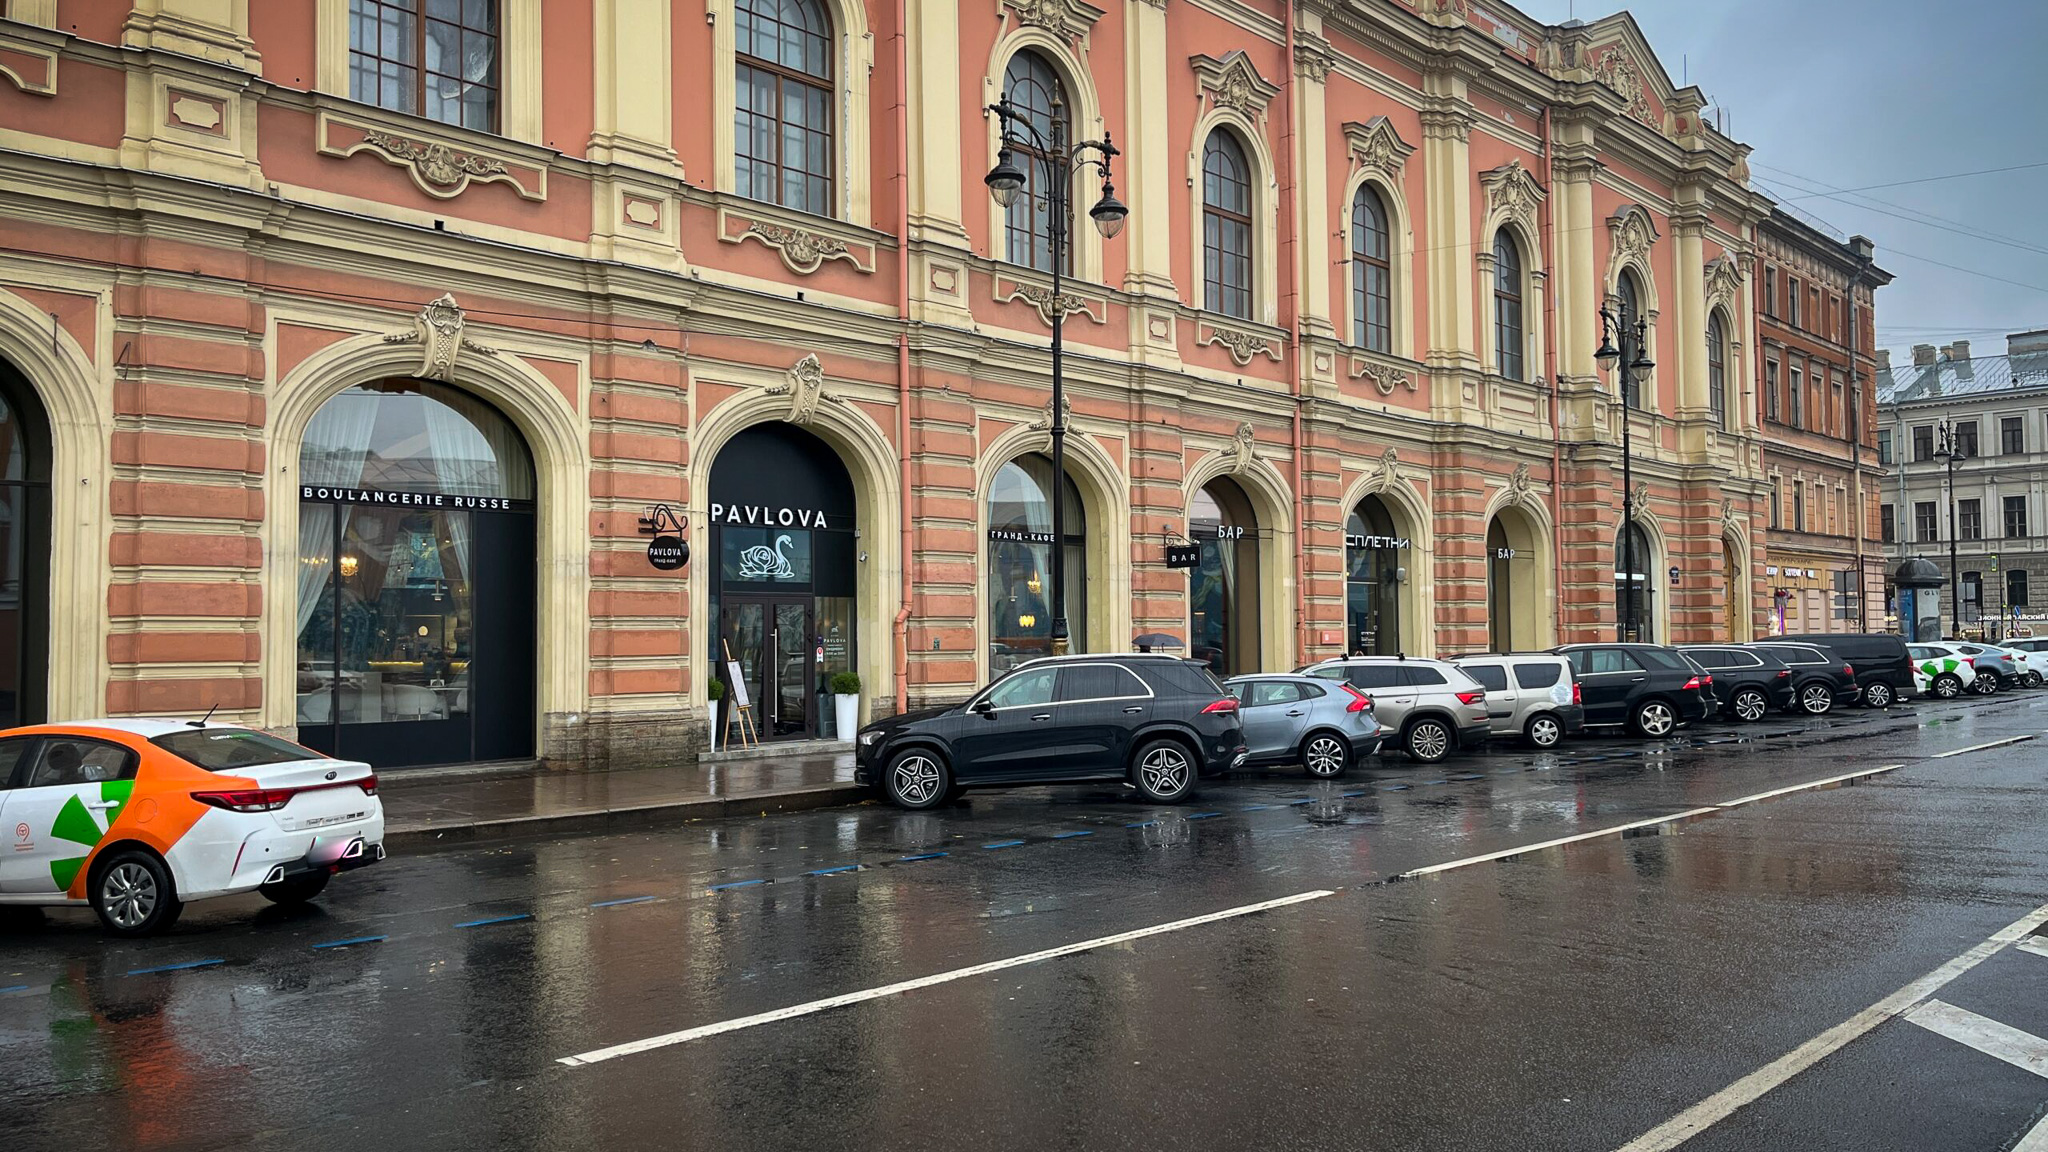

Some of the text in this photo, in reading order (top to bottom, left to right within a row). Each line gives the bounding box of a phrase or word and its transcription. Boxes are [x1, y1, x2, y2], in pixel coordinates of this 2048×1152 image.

[303, 487, 510, 510] BOULANGERIE RUSSE
[711, 503, 828, 529] PAVLOVA
[991, 530, 1055, 542] ГРАНД-КАФЕ
[1217, 525, 1244, 540] БАР
[1346, 534, 1409, 550] СПЛЕТНИ
[649, 547, 682, 557] PAVLOVA
[1171, 553, 1196, 562] BAR
[1497, 548, 1516, 559] БАР
